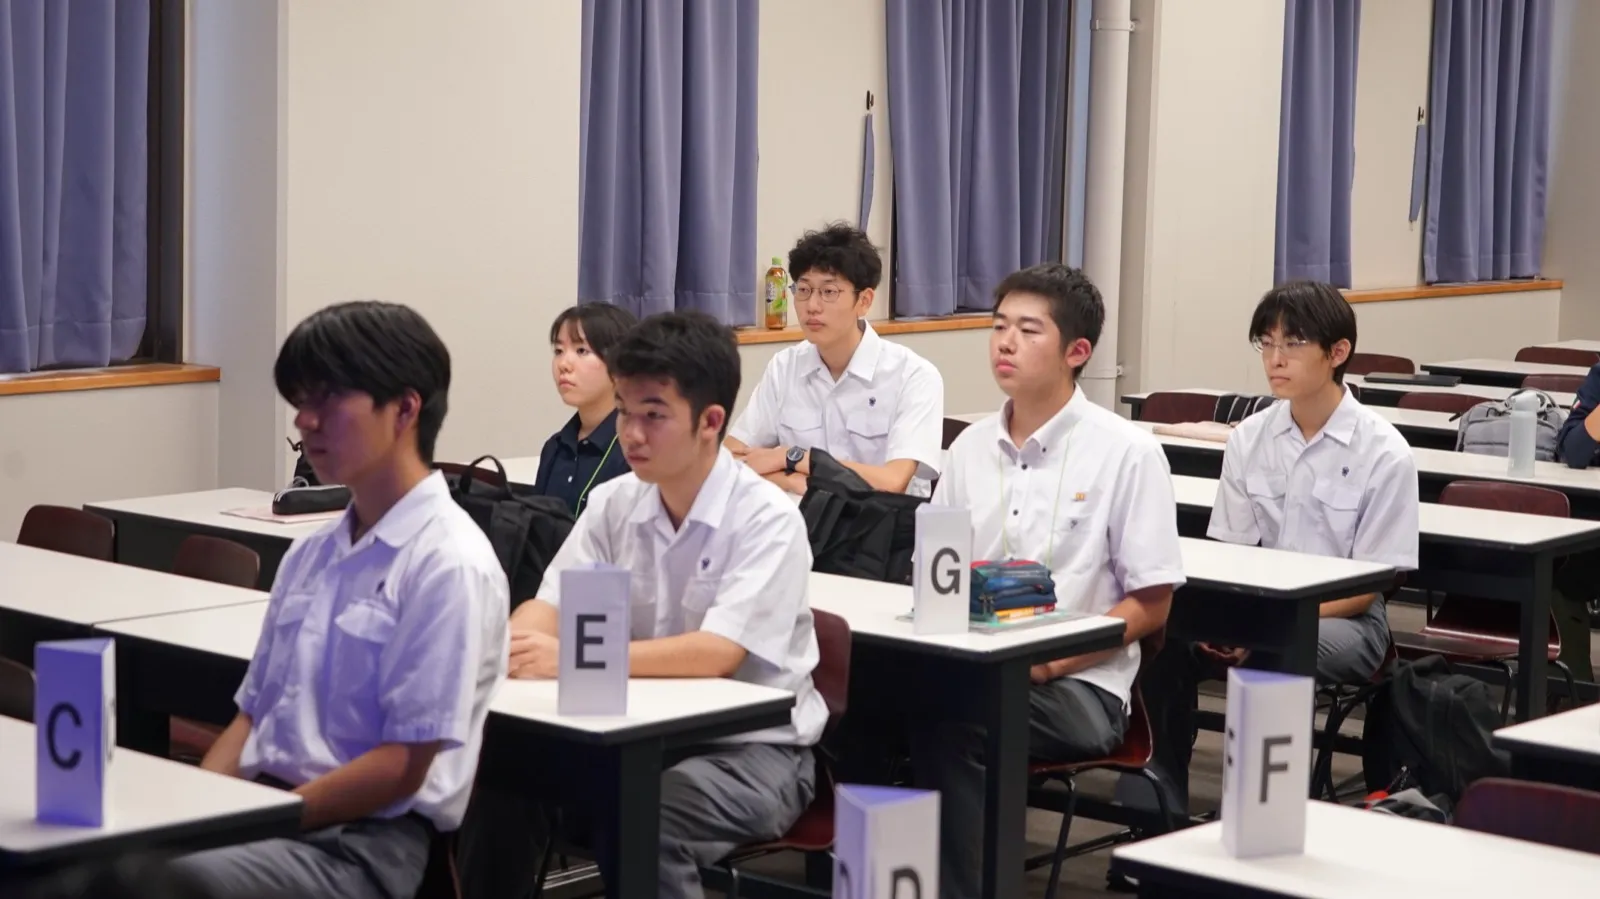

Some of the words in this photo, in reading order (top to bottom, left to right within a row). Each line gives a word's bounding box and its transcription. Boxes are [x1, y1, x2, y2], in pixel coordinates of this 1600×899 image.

[930, 547, 961, 595] G
[575, 613, 607, 670] E
[46, 702, 82, 771] C
[1259, 735, 1293, 804] F
